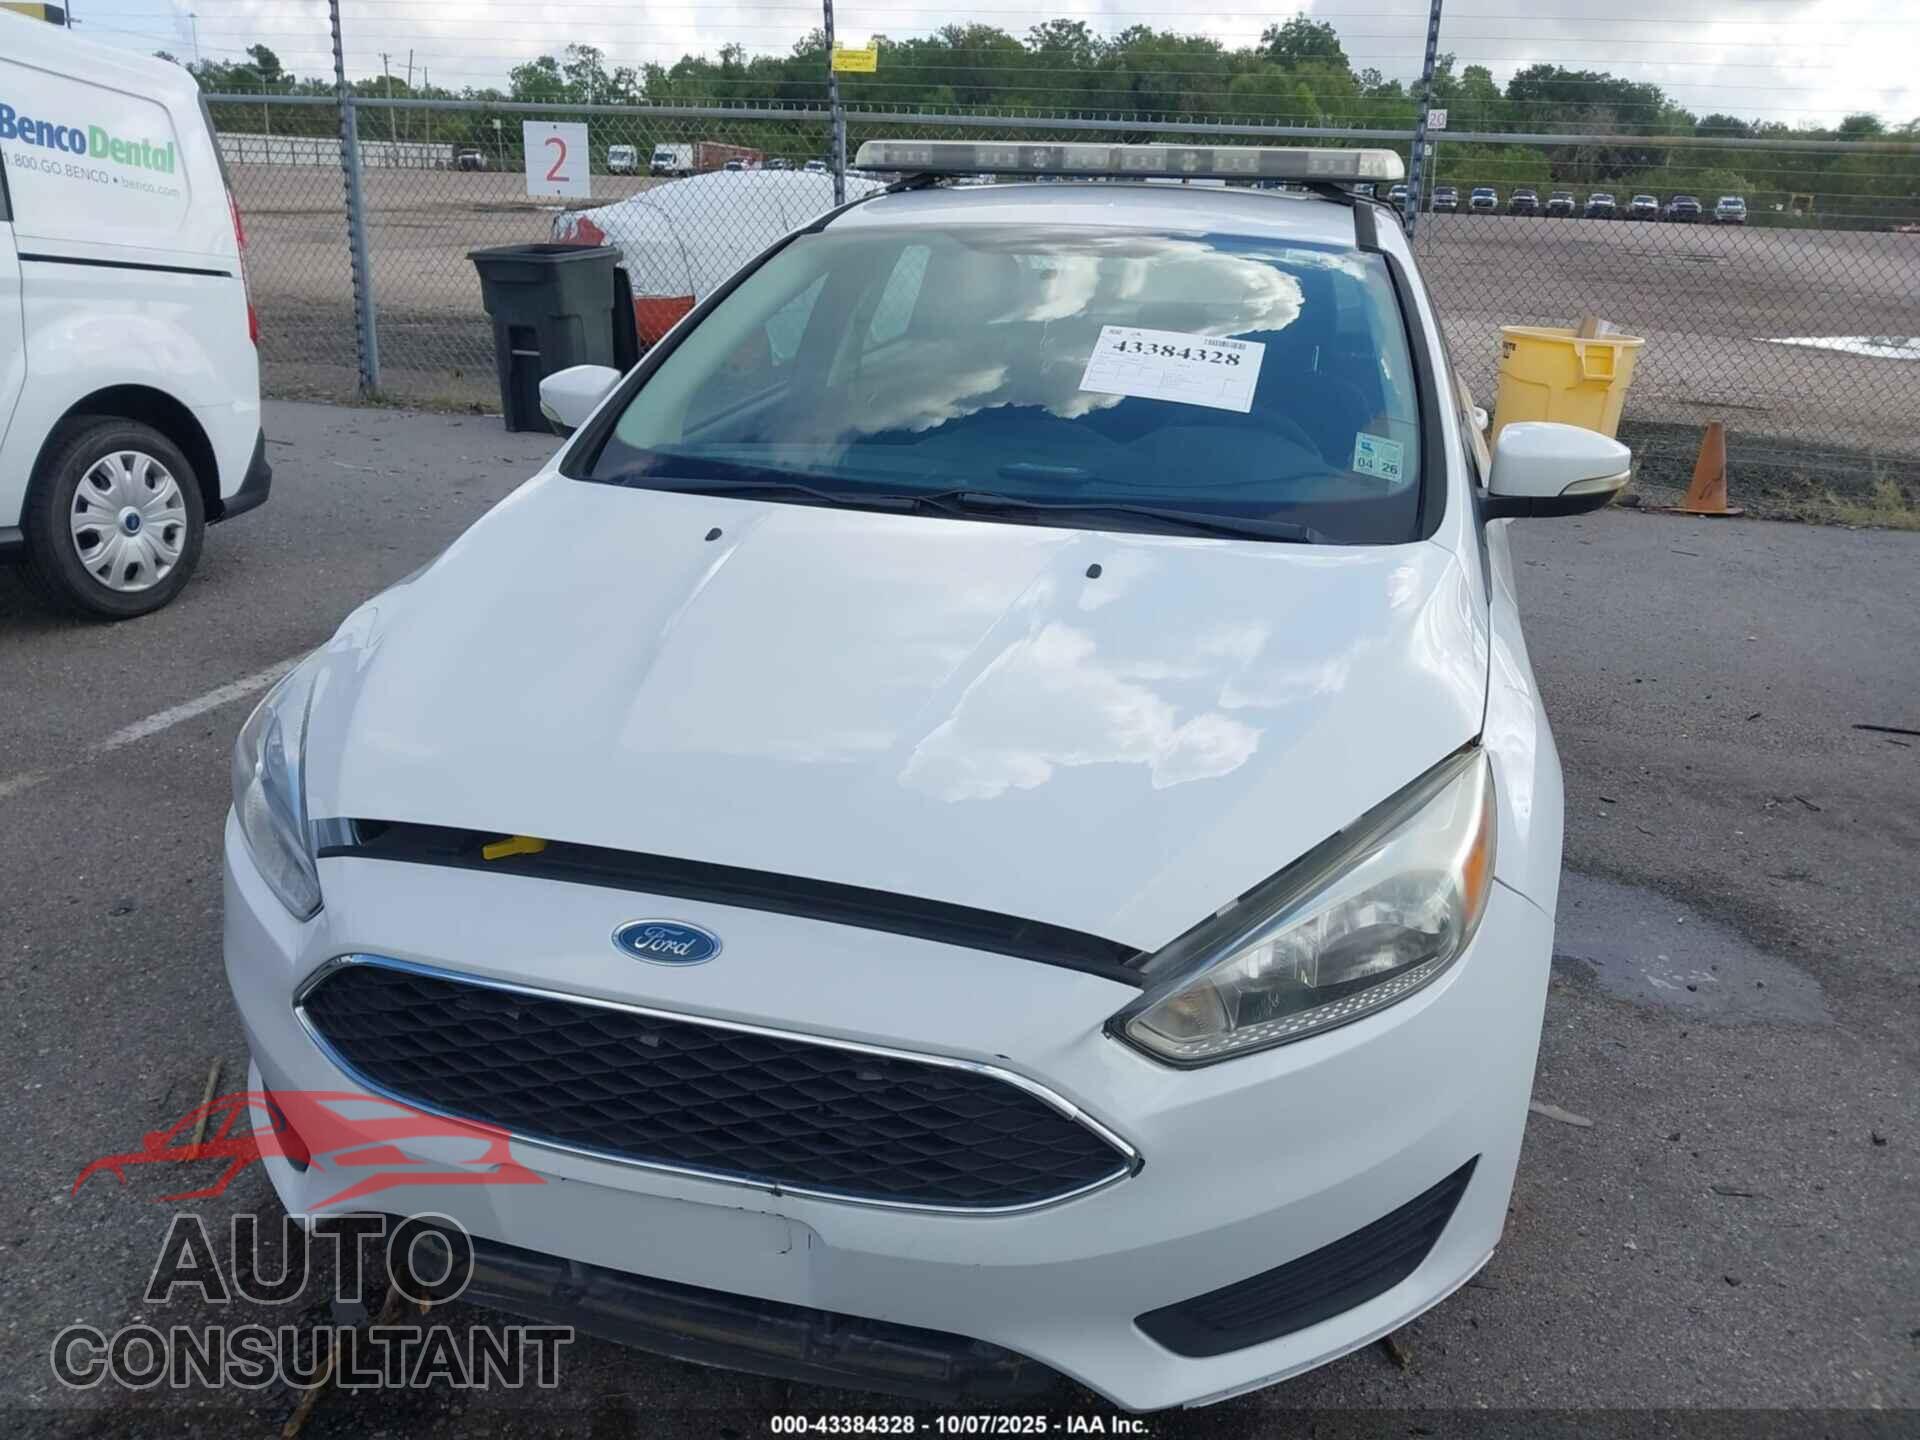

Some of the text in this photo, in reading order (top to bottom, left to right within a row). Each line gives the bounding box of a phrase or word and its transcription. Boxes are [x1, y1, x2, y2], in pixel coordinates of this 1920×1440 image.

[544, 136, 569, 182] 2
[120, 175, 181, 199] benco.com
[1112, 340, 1241, 366] 43384328
[1358, 456, 1398, 475] 04 26
[634, 926, 697, 956] Ford
